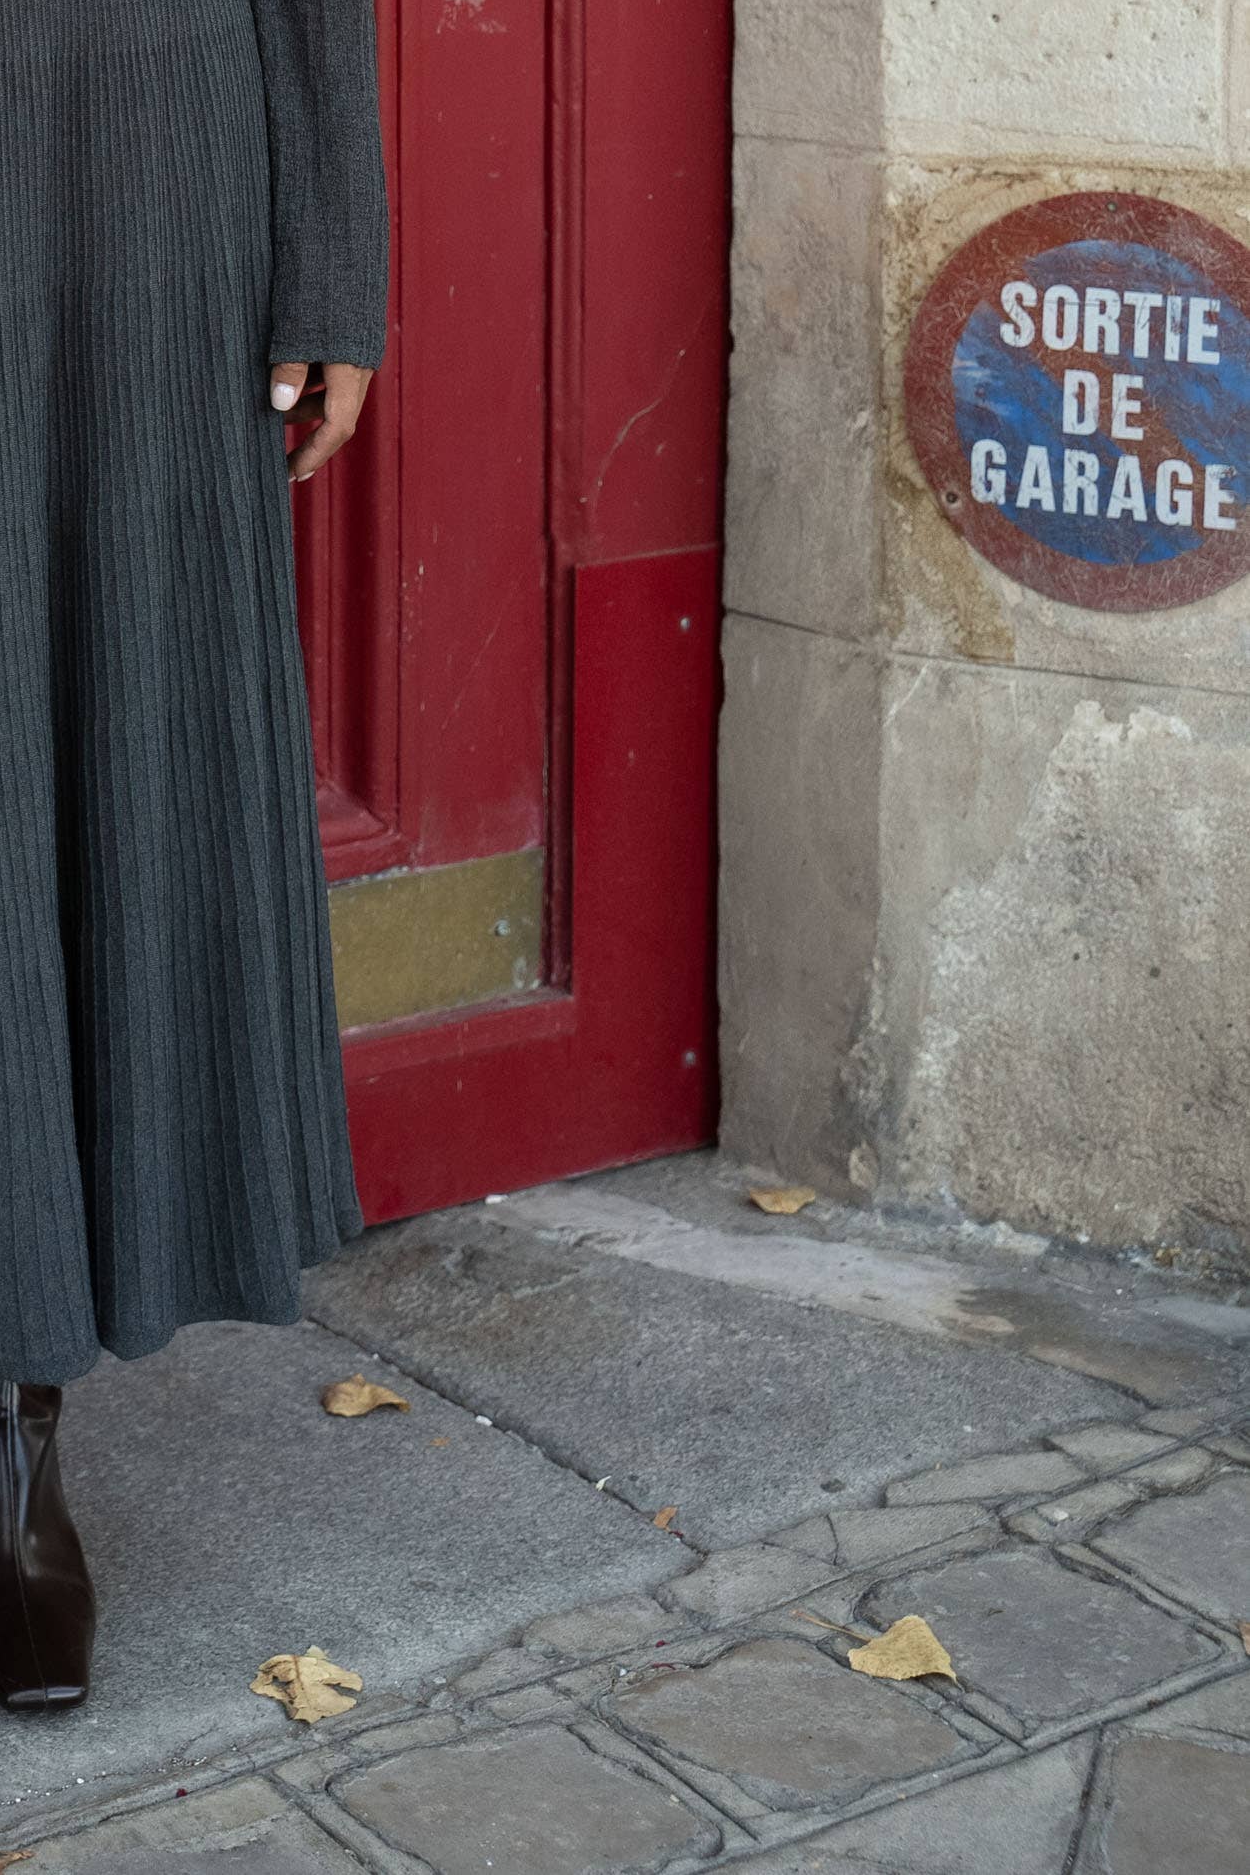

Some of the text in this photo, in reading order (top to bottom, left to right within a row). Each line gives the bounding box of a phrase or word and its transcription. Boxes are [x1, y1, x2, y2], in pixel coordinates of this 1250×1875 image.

[1000, 281, 1221, 365] SORTIE
[1062, 369, 1145, 441] DE
[970, 439, 1237, 531] GARAGE
